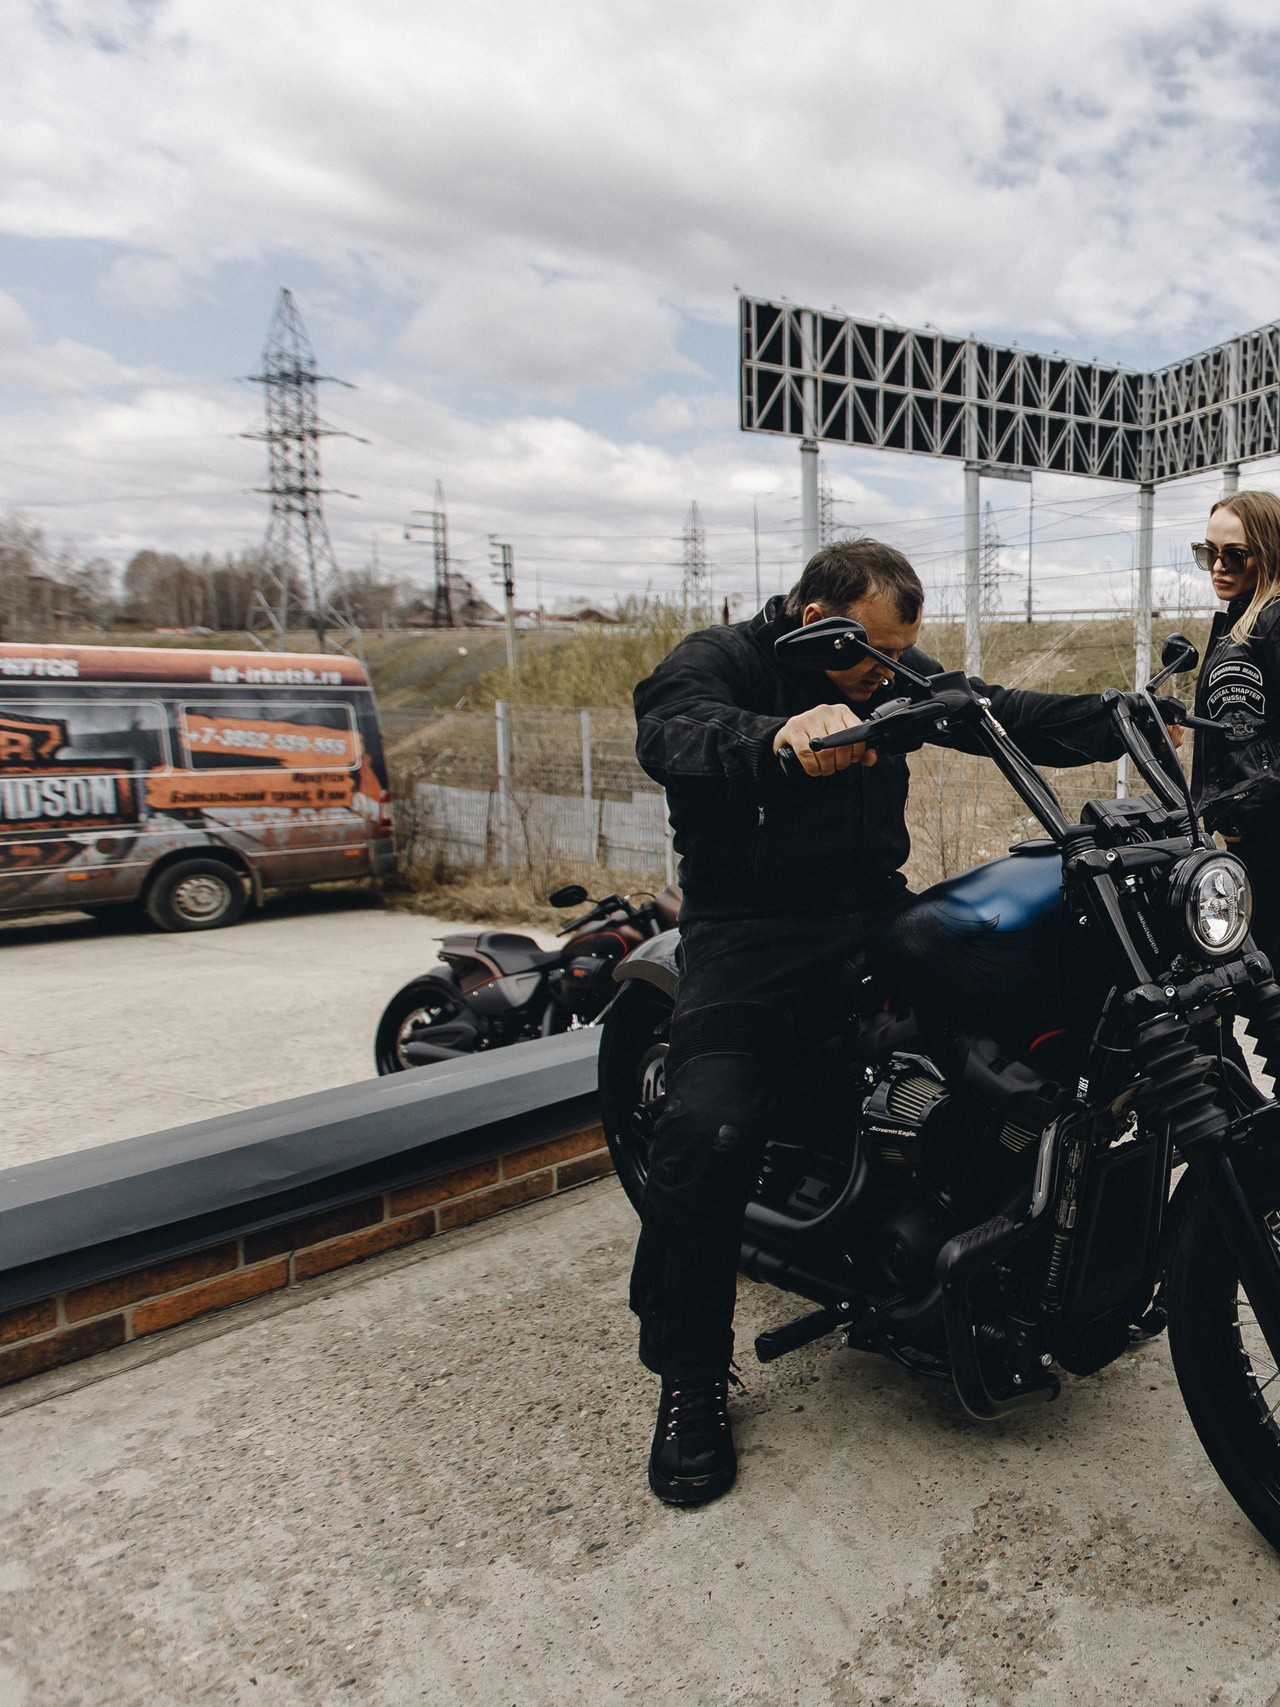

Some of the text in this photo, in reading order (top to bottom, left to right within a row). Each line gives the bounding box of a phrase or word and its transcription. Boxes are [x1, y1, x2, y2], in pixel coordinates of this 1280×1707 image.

[0, 657, 79, 677] КУТСК
[1242, 667, 1260, 680] DEALER
[1210, 686, 1261, 704] BAIKAL CHAPTER
[1221, 694, 1247, 702] RUSSIA
[0, 778, 117, 819] IDSON
